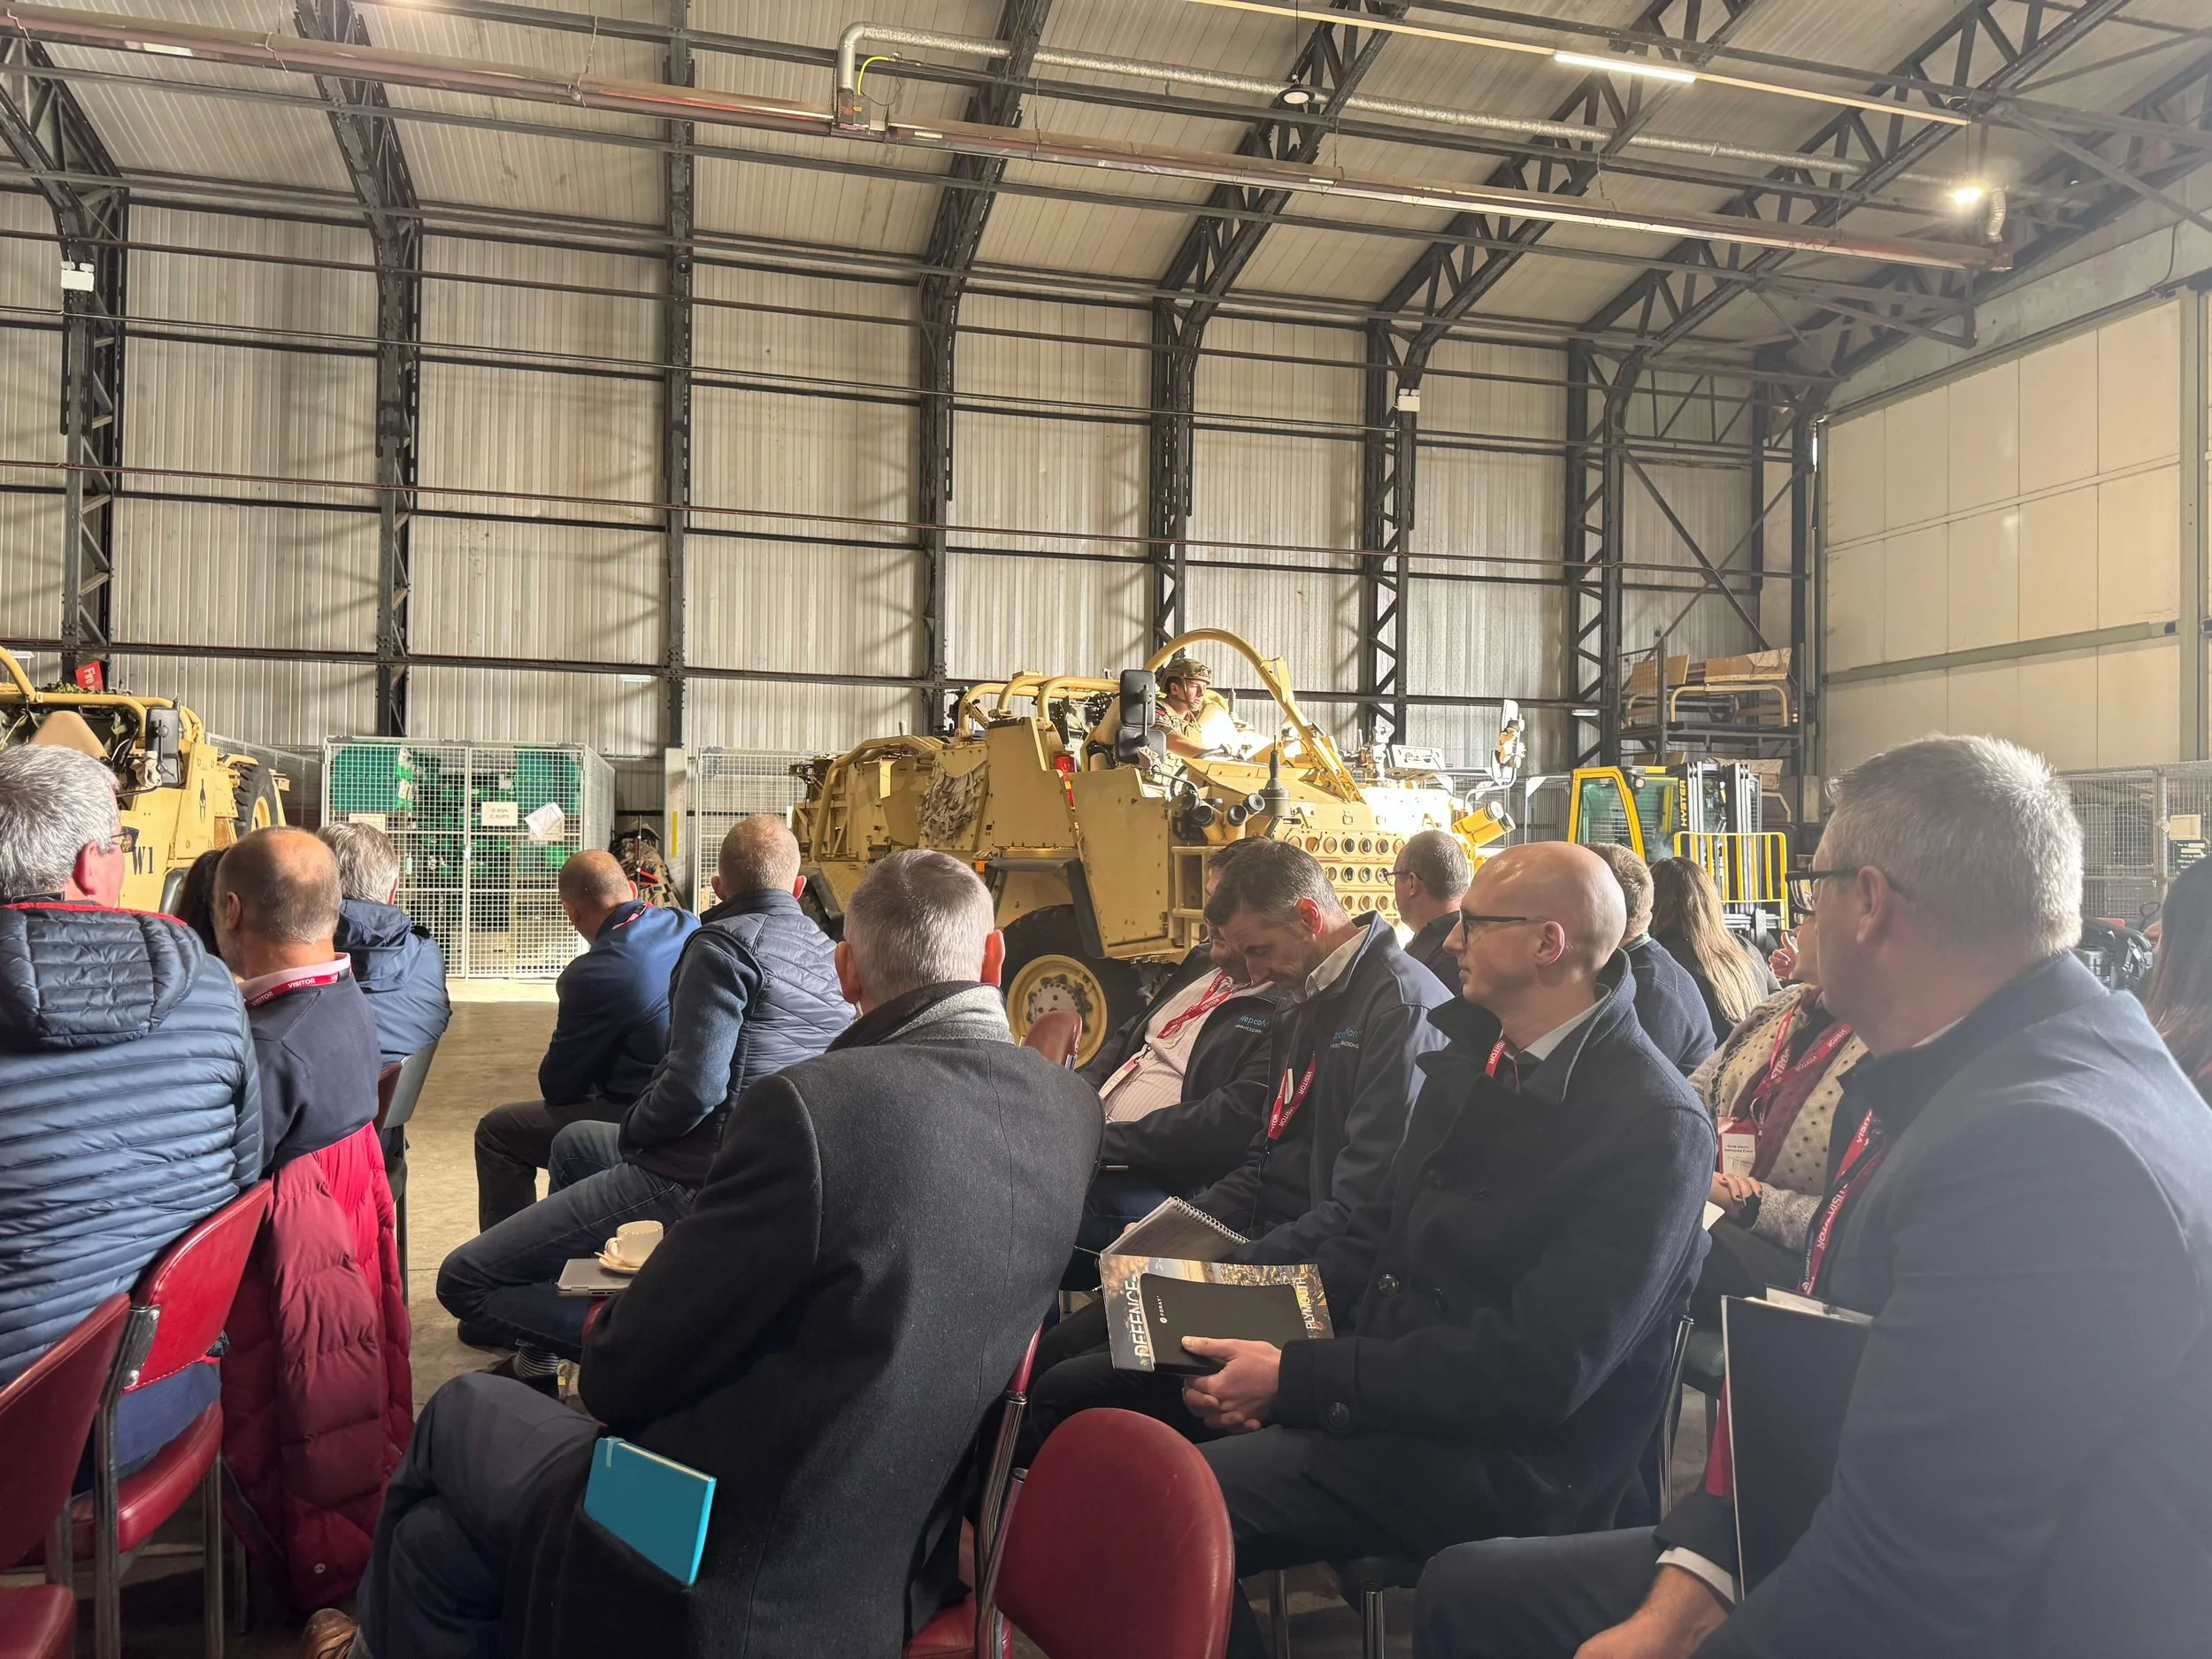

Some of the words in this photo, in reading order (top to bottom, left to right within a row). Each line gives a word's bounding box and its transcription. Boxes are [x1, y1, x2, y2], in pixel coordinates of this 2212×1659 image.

[84, 666, 96, 685] Fire
[288, 977, 316, 988] VISITOR
[251, 990, 274, 1006] VISITOR
[1825, 1029, 1847, 1048] VISITOR
[1298, 1071, 1313, 1095] VISITOR
[1295, 1277, 1317, 1330] PLYMOUTH
